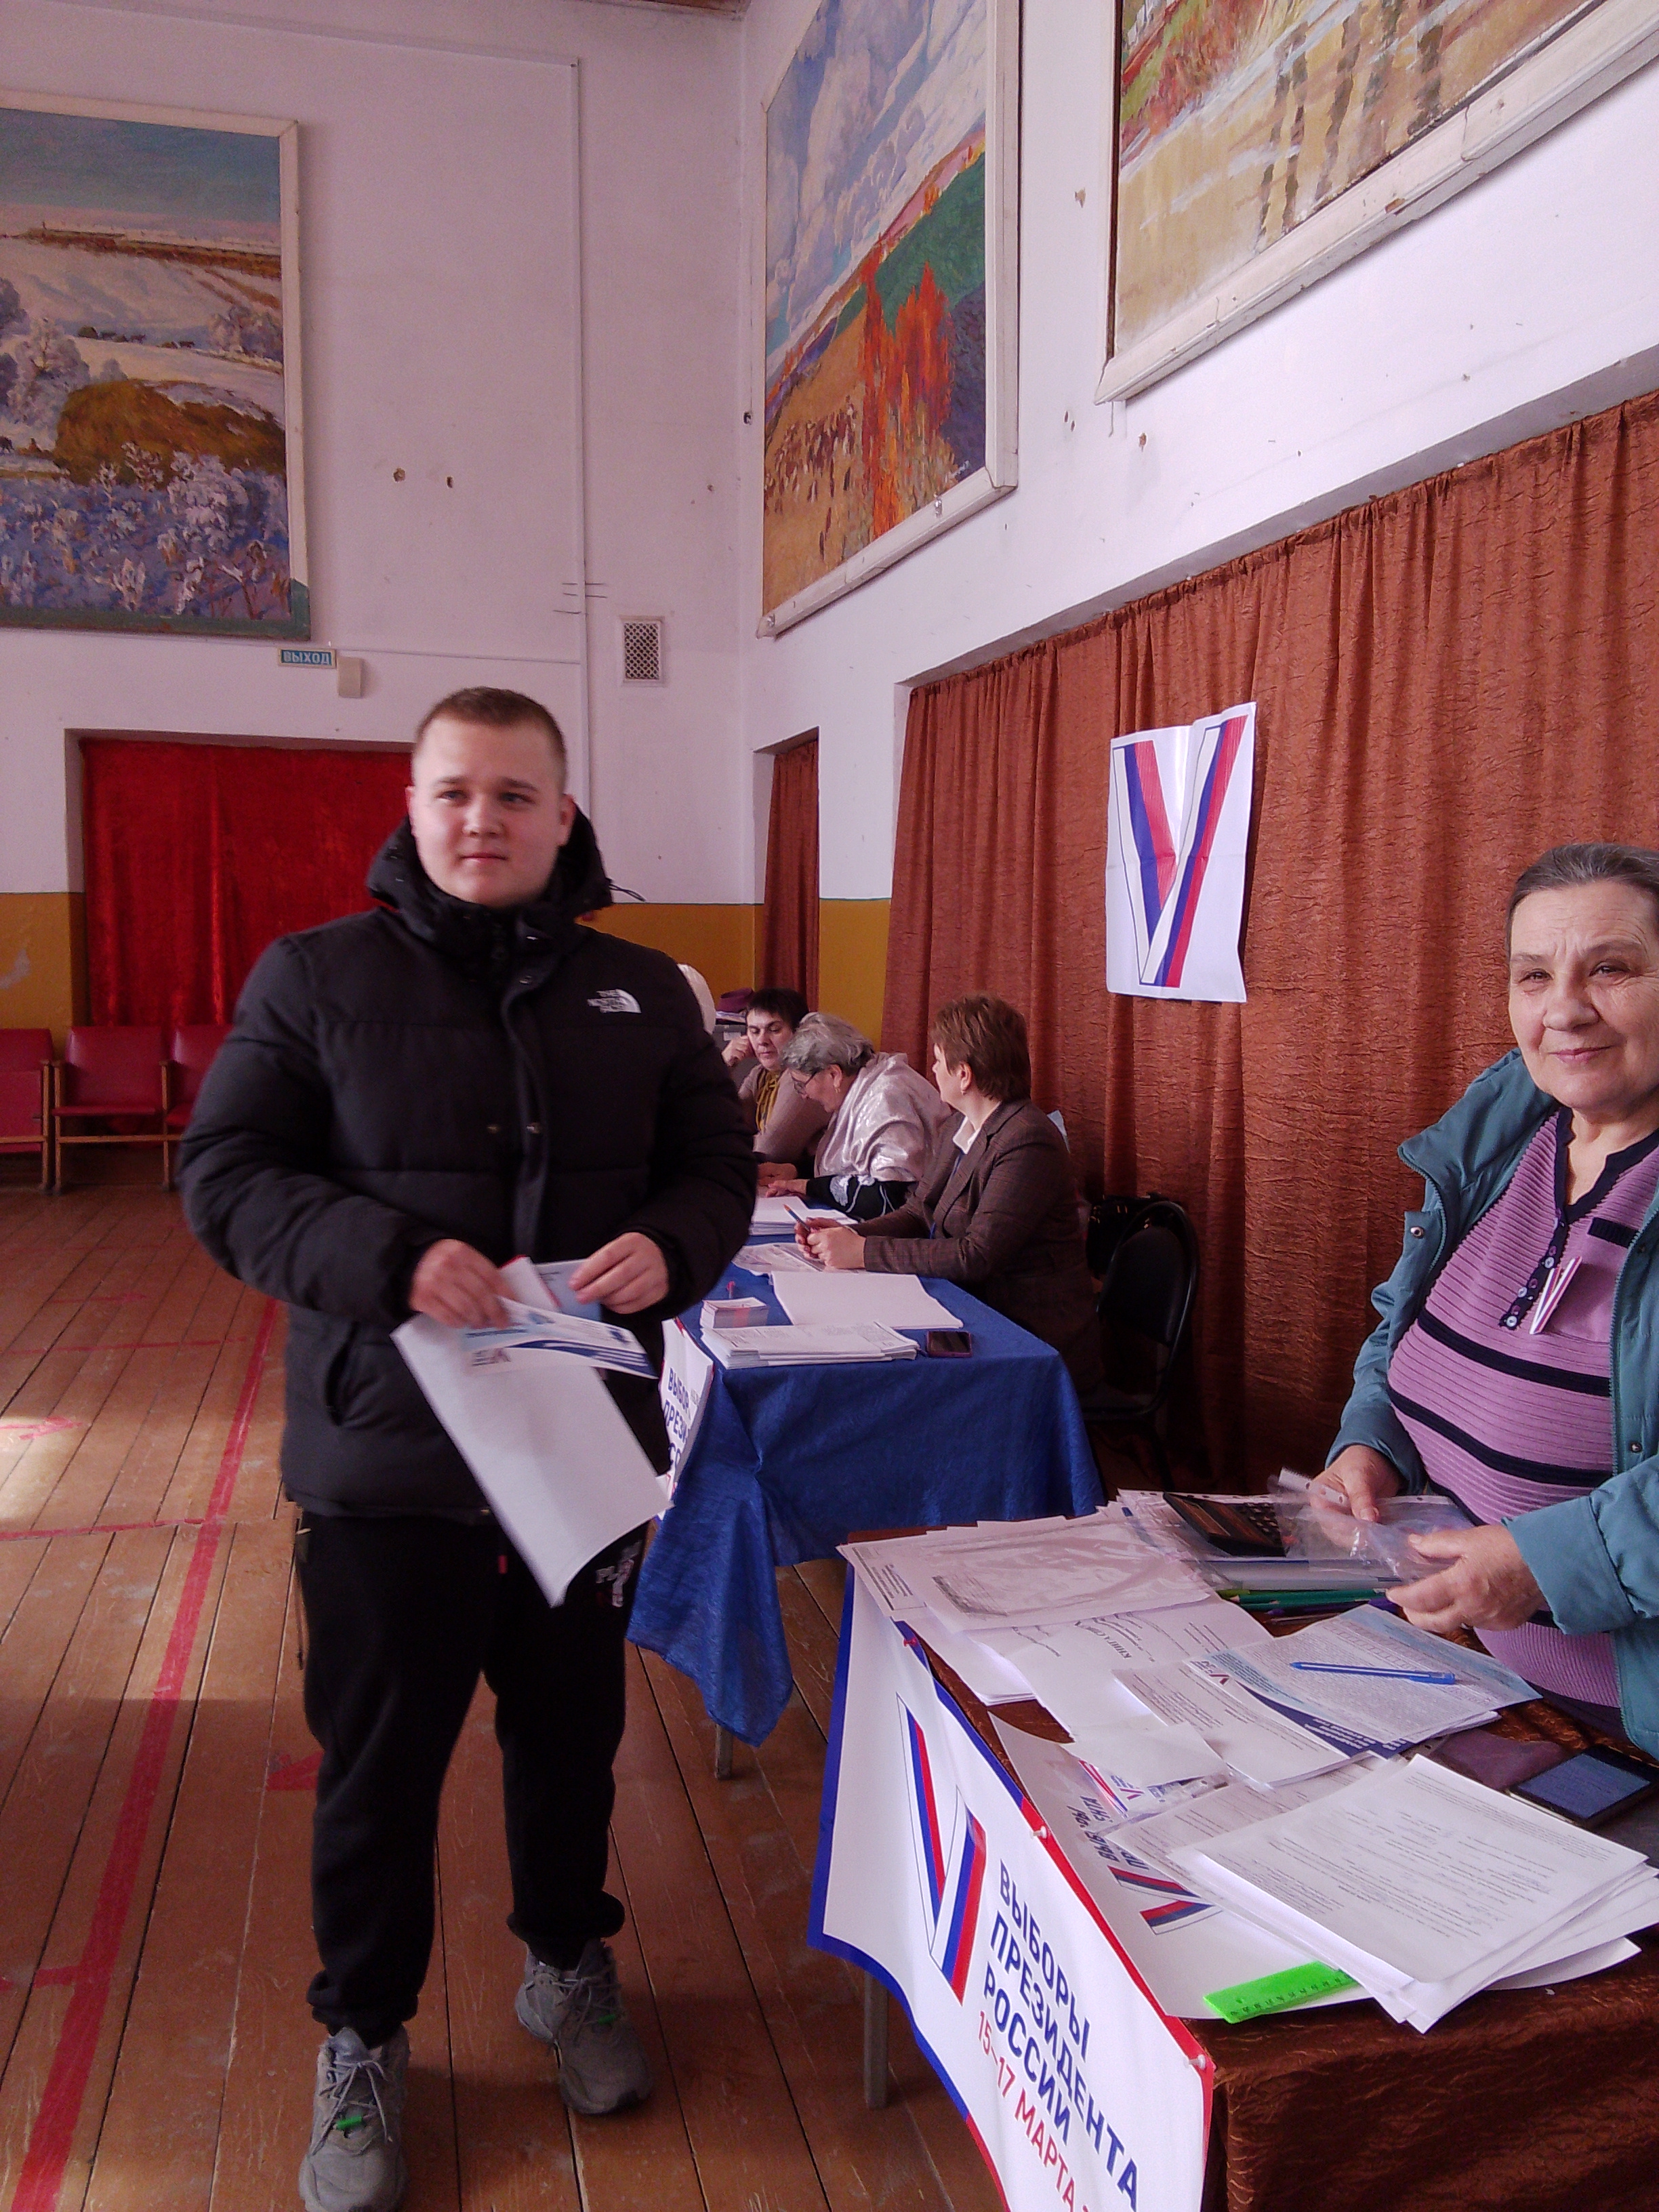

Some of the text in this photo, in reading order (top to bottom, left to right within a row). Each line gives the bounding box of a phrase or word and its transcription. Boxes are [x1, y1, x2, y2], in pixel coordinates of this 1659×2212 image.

[283, 651, 330, 665] ВЫХОД
[1000, 1858, 1090, 2063] ВЫБОРЫ
[983, 1961, 1071, 2147] РОССИИ
[989, 1909, 1138, 2212] ПРЕЗИДЕНТА
[1015, 2087, 1075, 2212] МАРТА
